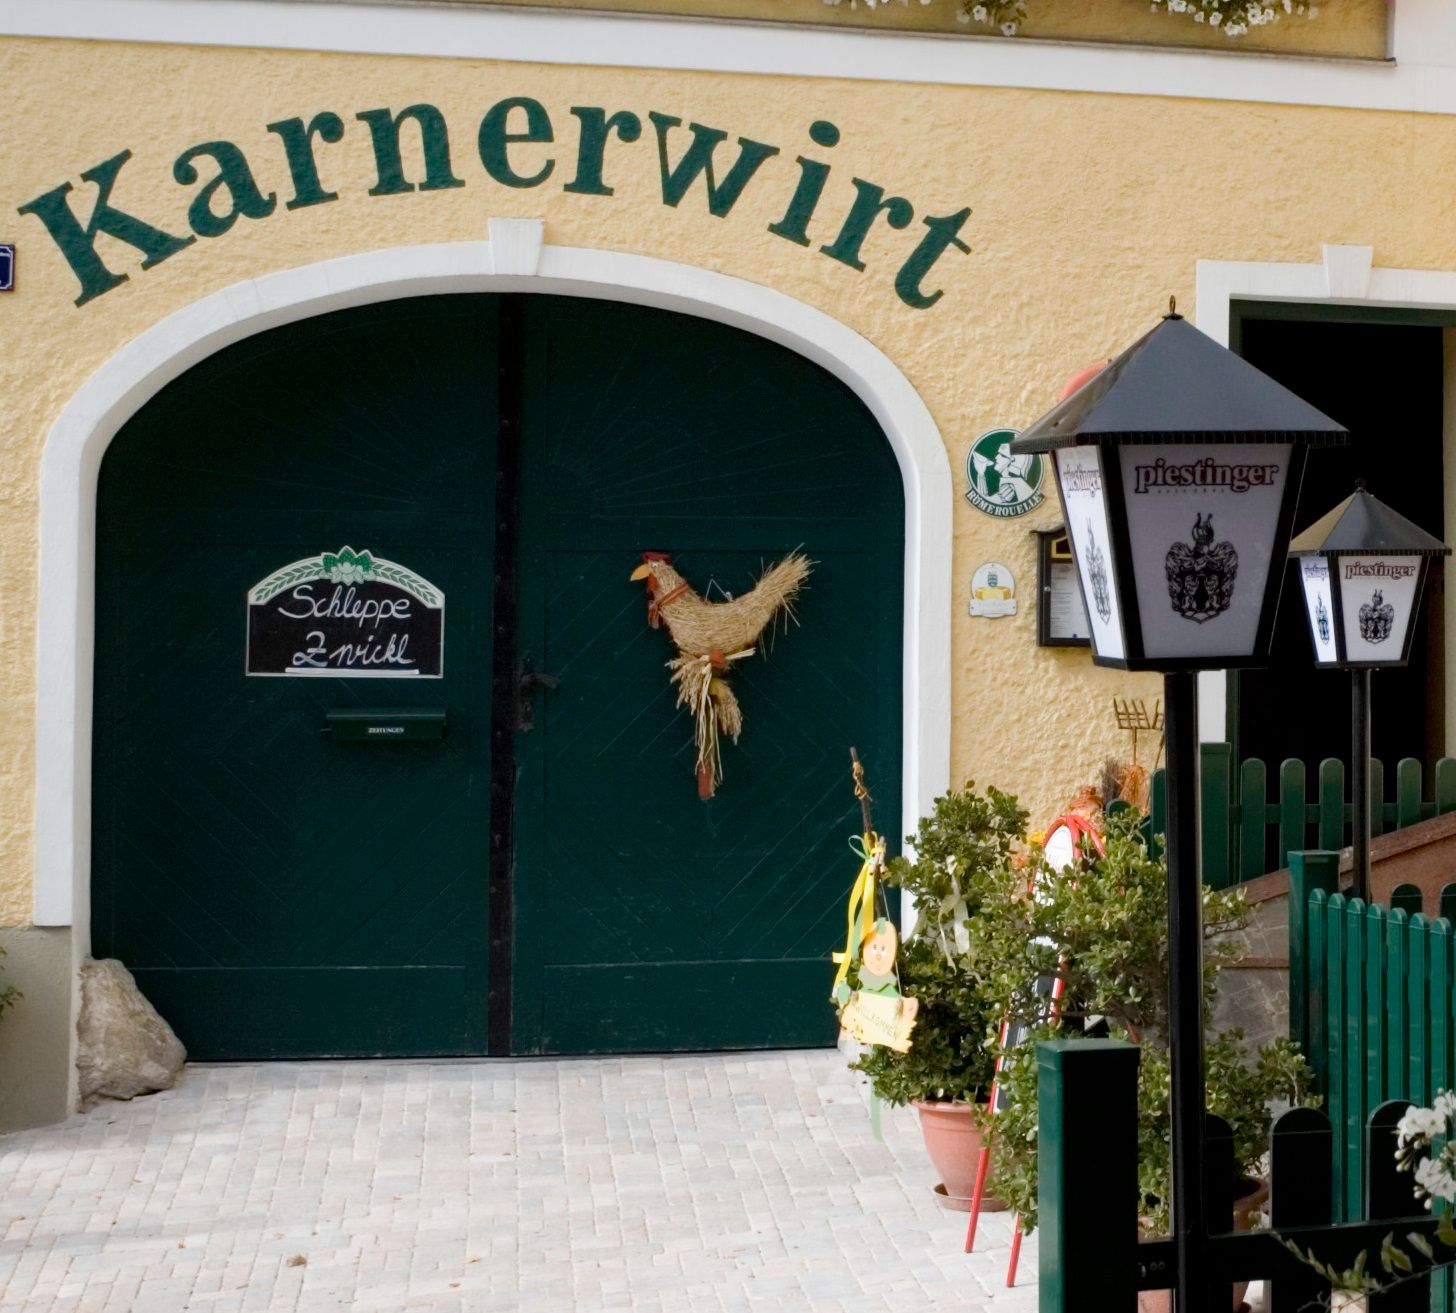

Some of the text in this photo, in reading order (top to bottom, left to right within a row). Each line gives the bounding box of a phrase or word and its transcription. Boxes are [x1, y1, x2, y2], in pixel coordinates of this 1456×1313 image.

[17, 96, 973, 309] Karnerwirt
[1135, 457, 1280, 494] piestinger
[1344, 561, 1416, 580] piestinger
[278, 584, 412, 628] Schleppe
